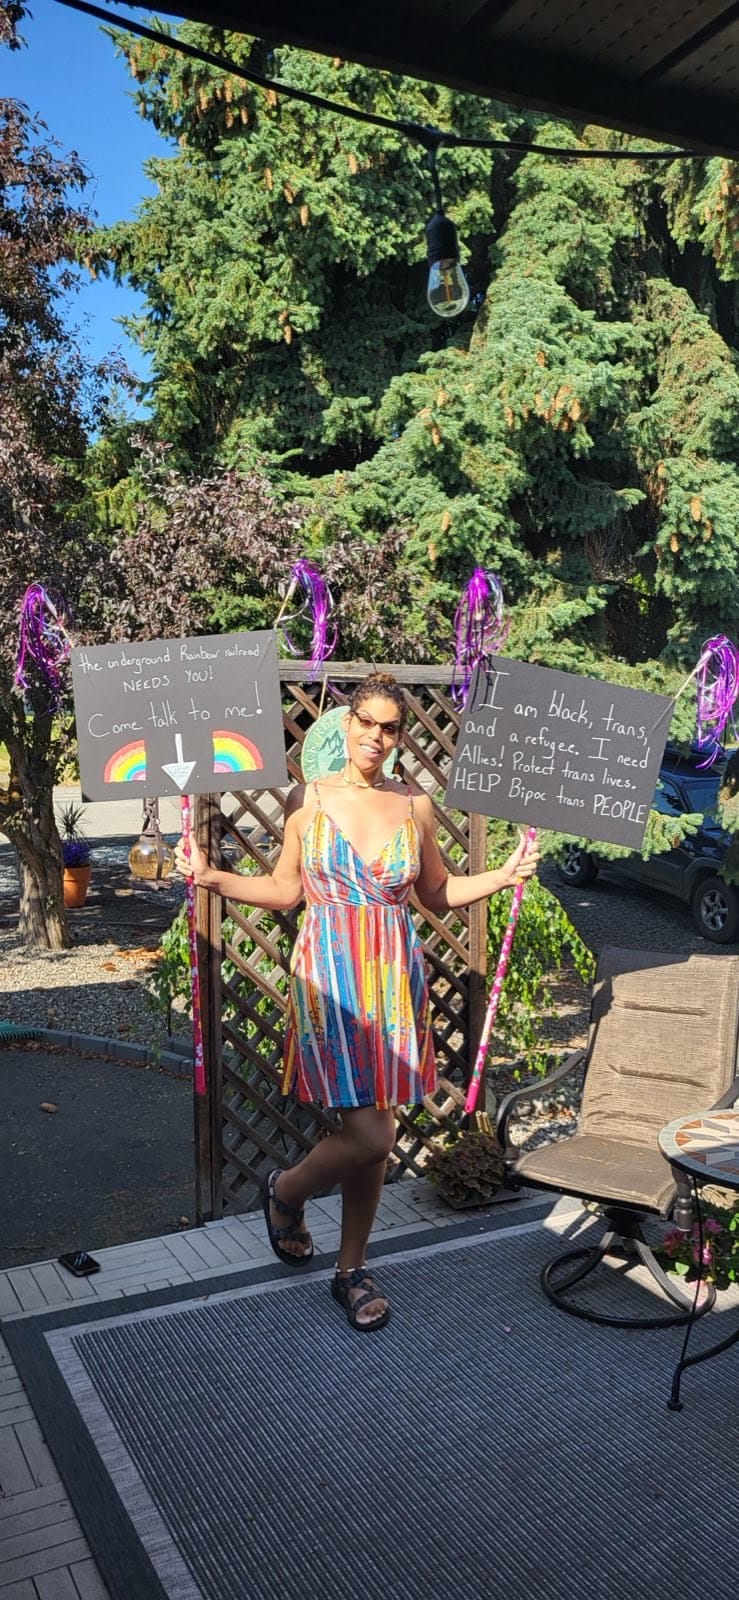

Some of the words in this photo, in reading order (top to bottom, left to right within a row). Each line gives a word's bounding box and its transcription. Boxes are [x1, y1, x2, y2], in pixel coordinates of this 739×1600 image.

[79, 653, 103, 674] the
[108, 648, 171, 673] underground
[180, 644, 219, 661] Rainbow
[224, 644, 260, 657] railroad
[123, 674, 170, 693] NEEDS
[185, 666, 214, 683] YOU!
[88, 713, 143, 738] Come
[148, 700, 178, 728] talk
[188, 698, 211, 721] to
[224, 680, 263, 719] me!
[478, 671, 510, 710] I
[514, 703, 538, 718] am
[547, 689, 593, 728] black,
[602, 704, 649, 746] trans,
[458, 744, 505, 768] Allies!
[513, 751, 555, 775] Protect
[562, 760, 595, 782] trans
[602, 768, 637, 790] lives.
[465, 717, 497, 738] and
[509, 733, 519, 743] a
[525, 727, 580, 759] refugee.
[588, 737, 612, 761] I
[617, 747, 650, 769] need
[454, 767, 501, 793] HELP
[508, 778, 547, 806] Bipoc
[556, 785, 585, 808] trans
[593, 794, 647, 824] PEOPLE
